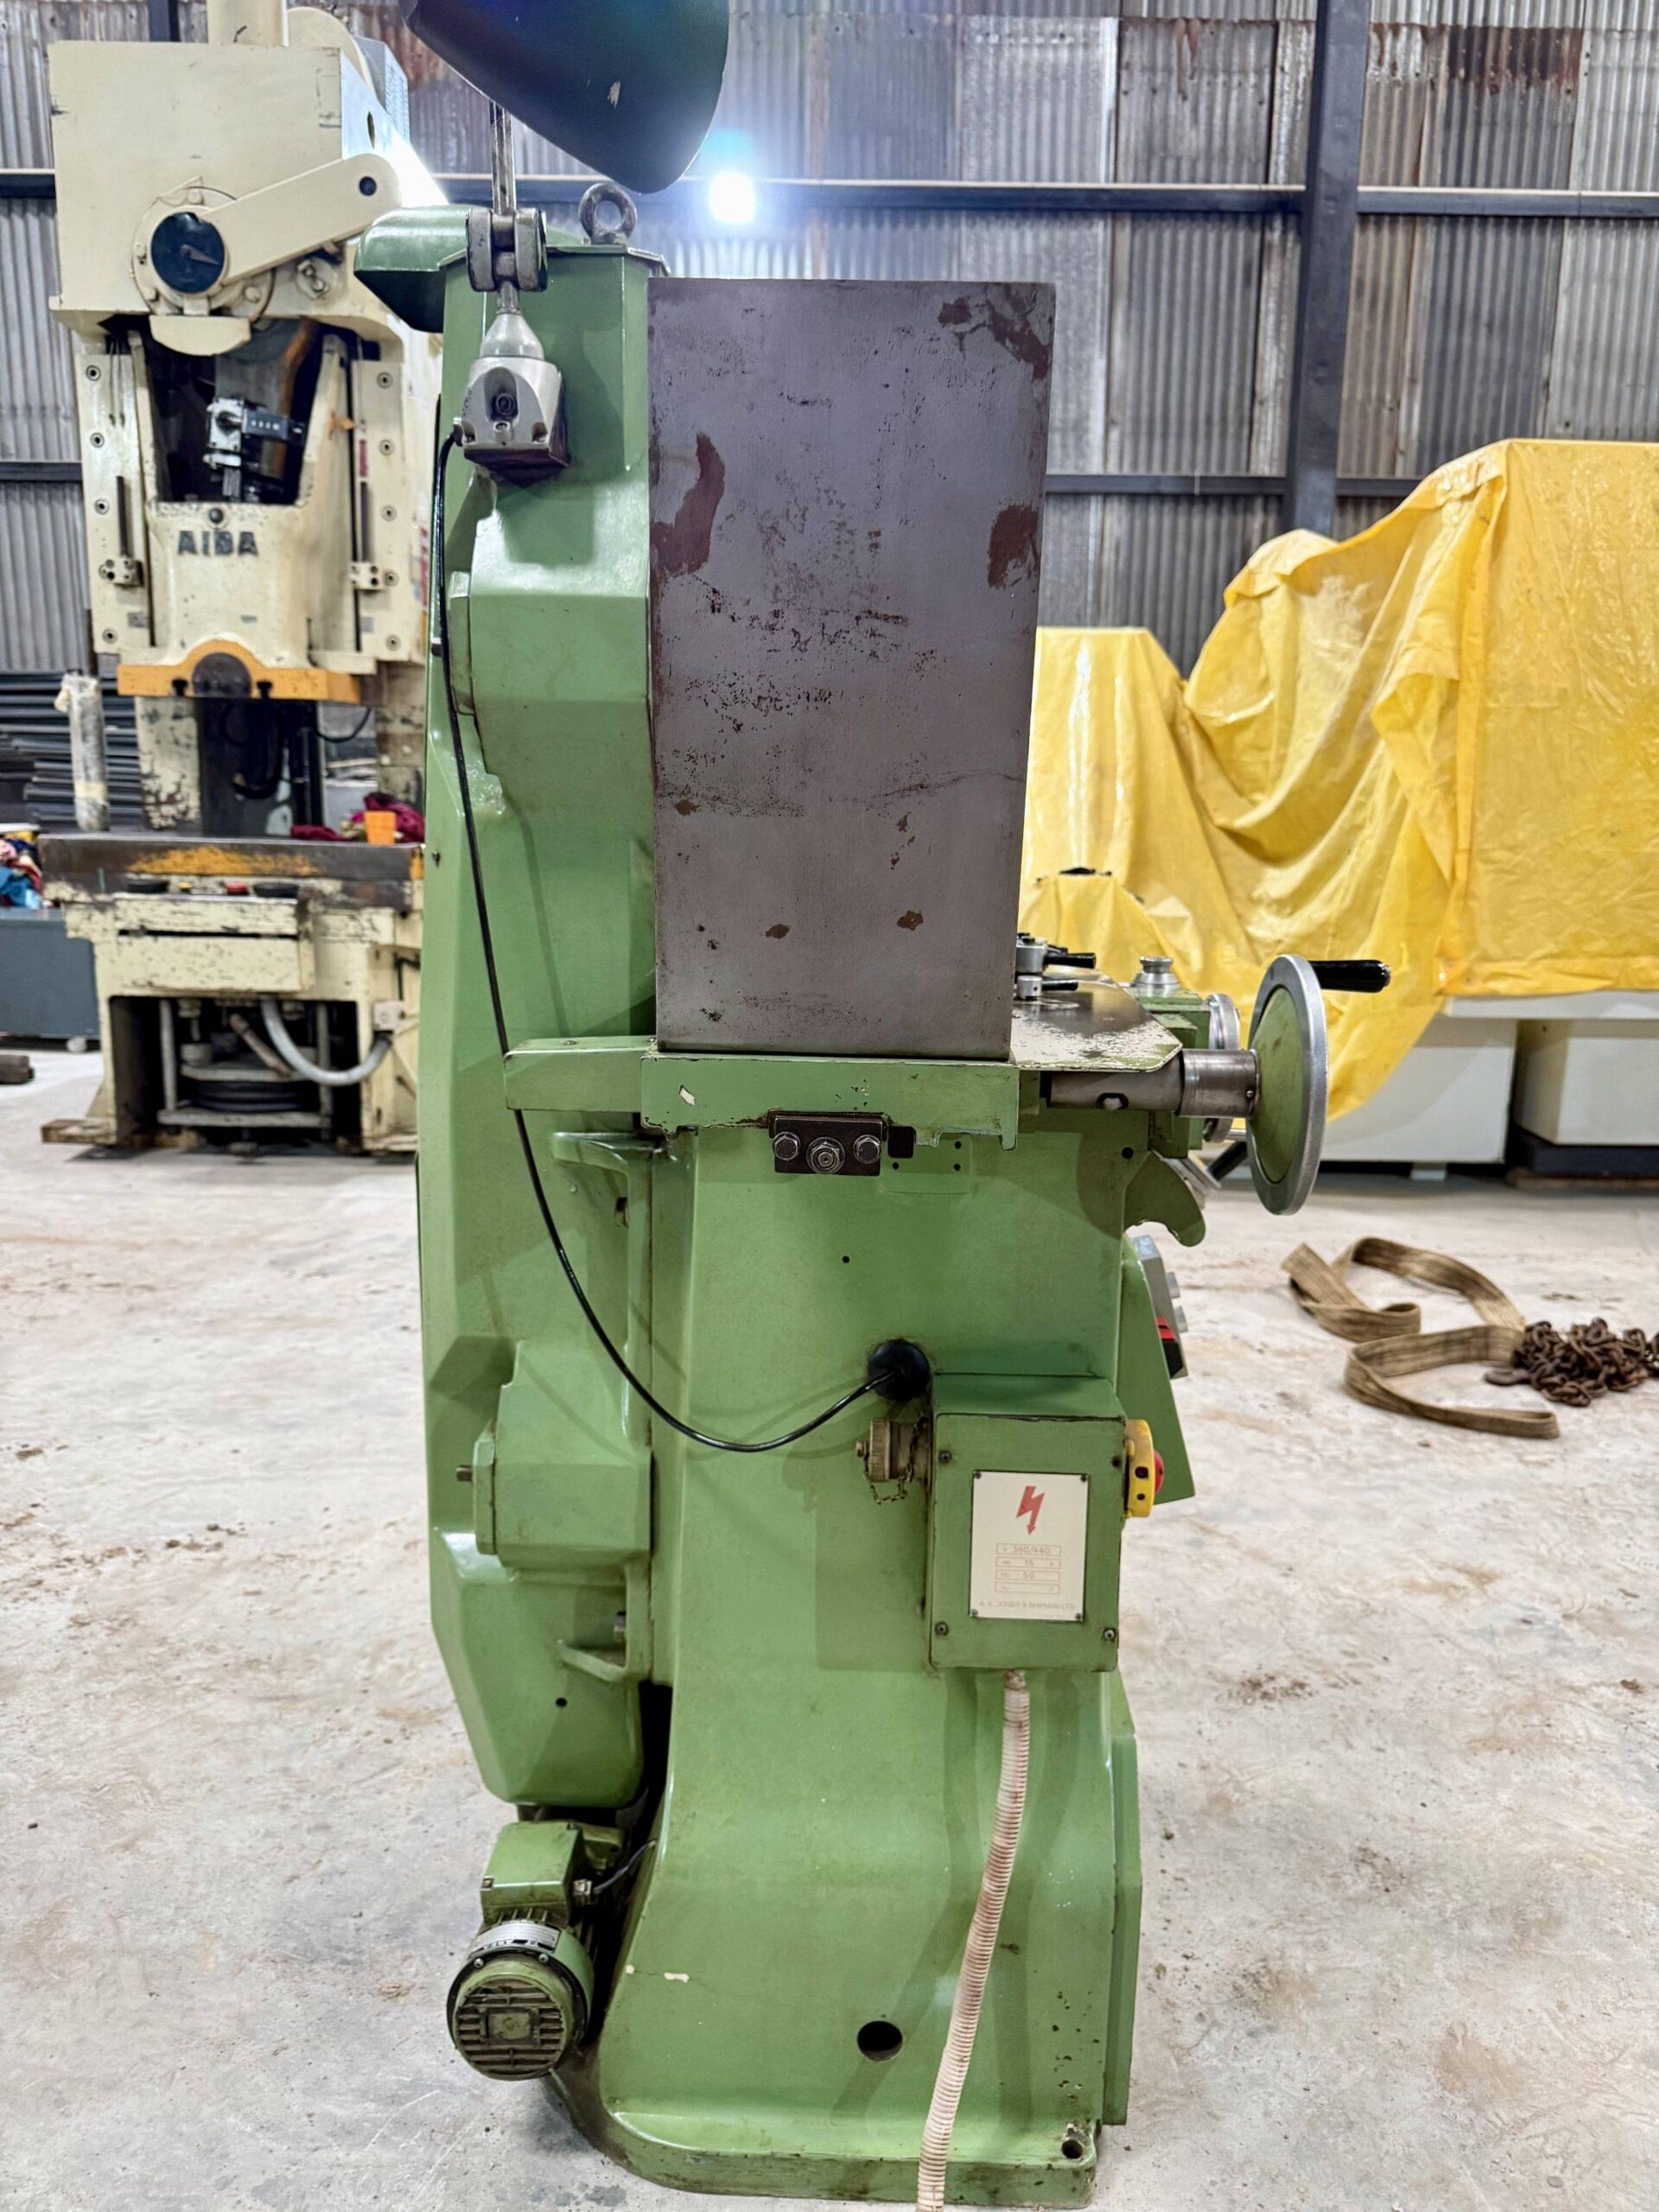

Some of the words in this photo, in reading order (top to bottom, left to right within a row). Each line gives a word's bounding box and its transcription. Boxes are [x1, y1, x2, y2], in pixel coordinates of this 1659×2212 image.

[177, 530, 259, 556] AIDA
[1012, 1545, 1051, 1554] 380/440
[1022, 1571, 1036, 1580] 50
